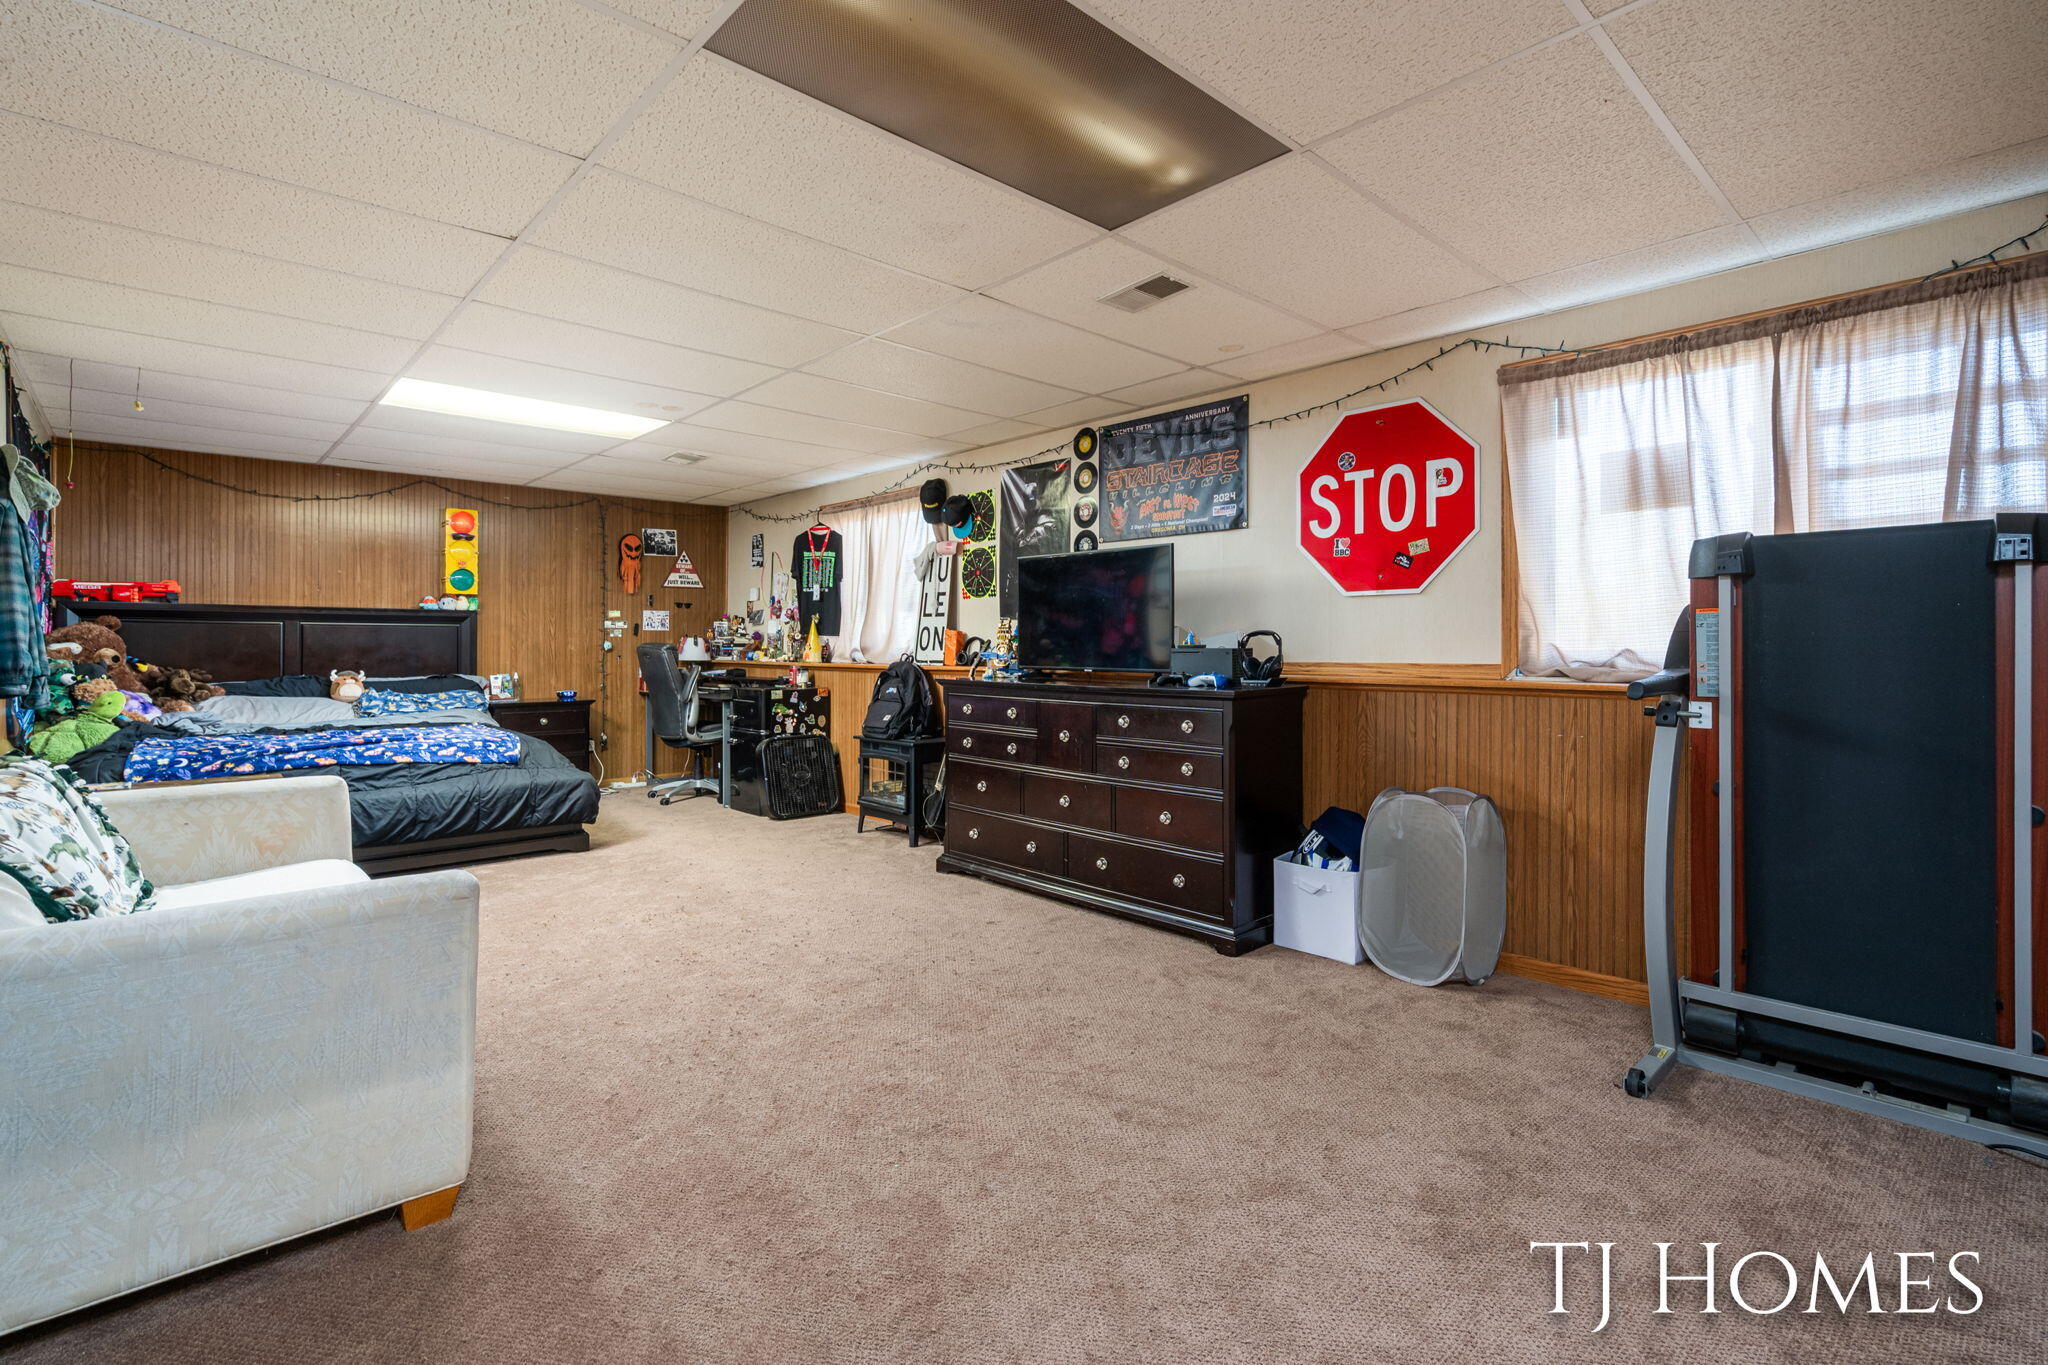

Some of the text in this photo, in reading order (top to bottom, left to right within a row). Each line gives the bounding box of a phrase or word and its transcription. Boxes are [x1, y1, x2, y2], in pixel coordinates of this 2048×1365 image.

[1135, 423, 1152, 432] FIFTH
[1184, 405, 1231, 422] ANNIVERSARY
[1106, 450, 1240, 492] STAIRCASE
[1213, 491, 1237, 503] 2024
[1308, 457, 1464, 539] STOP
[1334, 548, 1350, 556] BBC
[922, 592, 947, 618] LE
[919, 626, 945, 651] ON
